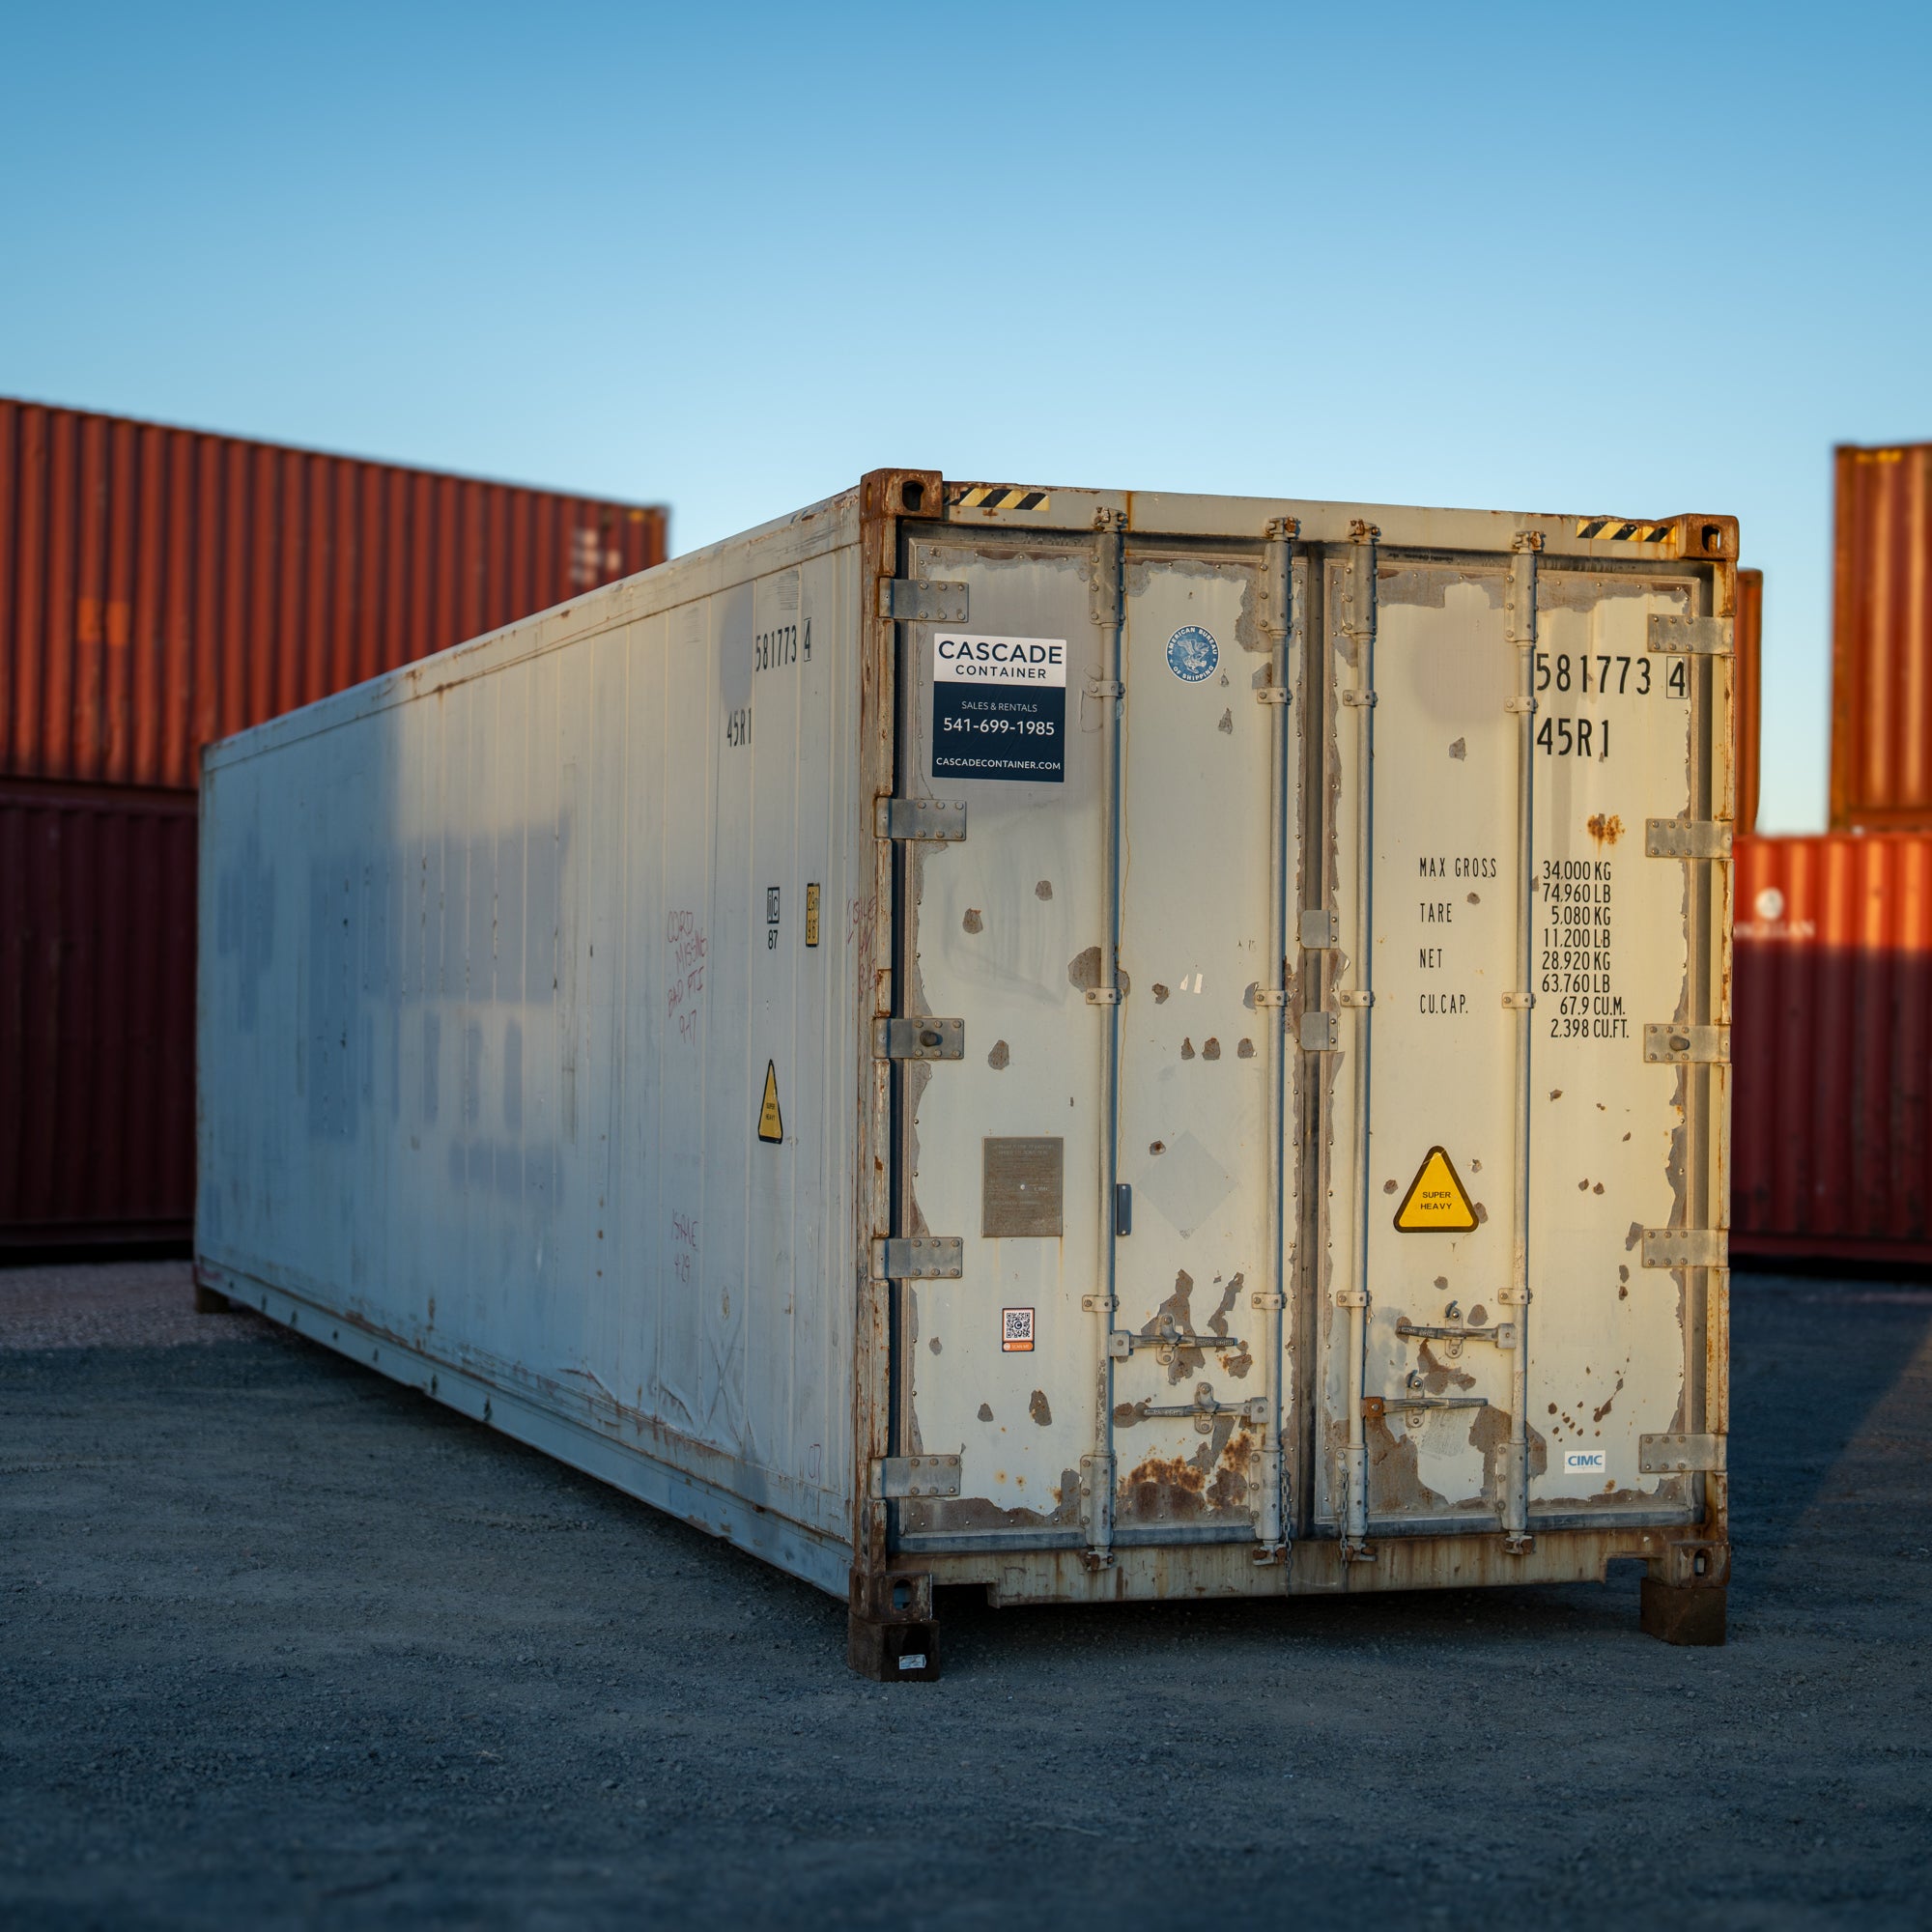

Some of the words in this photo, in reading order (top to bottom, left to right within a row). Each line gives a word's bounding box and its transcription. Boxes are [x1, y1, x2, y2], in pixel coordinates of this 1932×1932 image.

[755, 624, 797, 672] 581773
[1168, 627, 1196, 655] AMERICAN
[1198, 628, 1218, 655] BUREAU
[938, 639, 1063, 665] CASCADE
[955, 664, 1047, 679] CONTAINER
[1173, 666, 1182, 674] OF
[1181, 665, 1214, 681] SHIPPING
[1536, 652, 1651, 696] 581773
[1668, 656, 1686, 697] 4
[961, 700, 989, 711] SALES
[990, 701, 997, 711] &
[998, 702, 1037, 713] RENTALS
[726, 707, 752, 748] 45R1
[943, 717, 1055, 736] 541-699-1985
[1536, 717, 1608, 757] 45R1
[936, 757, 1061, 771] CASCADECONTAINER.COM
[1419, 857, 1446, 877] MAX
[1455, 857, 1496, 878] GROSS
[1543, 860, 1591, 881] 34,000
[1594, 861, 1611, 881] KG
[1543, 883, 1591, 903] 74,960
[1594, 883, 1611, 903] LB
[1419, 902, 1453, 923] TARE
[1551, 905, 1591, 925] 5,080
[1594, 906, 1611, 925] KG
[768, 929, 779, 951] 87
[1544, 928, 1590, 949] 11,200
[1594, 928, 1610, 949] LB
[1419, 948, 1443, 969] NET
[1542, 951, 1590, 971] 28,920
[1594, 951, 1610, 971] KG
[1542, 973, 1590, 993] 63,760
[1594, 974, 1610, 993] LB
[1419, 994, 1468, 1014] CU.CAP.
[1560, 996, 1590, 1015] 67.9
[1593, 996, 1626, 1016] CU.M.
[1550, 1018, 1589, 1038] 2,398
[1593, 1018, 1630, 1038] CU.FT.
[1568, 1454, 1603, 1466] CIMC
